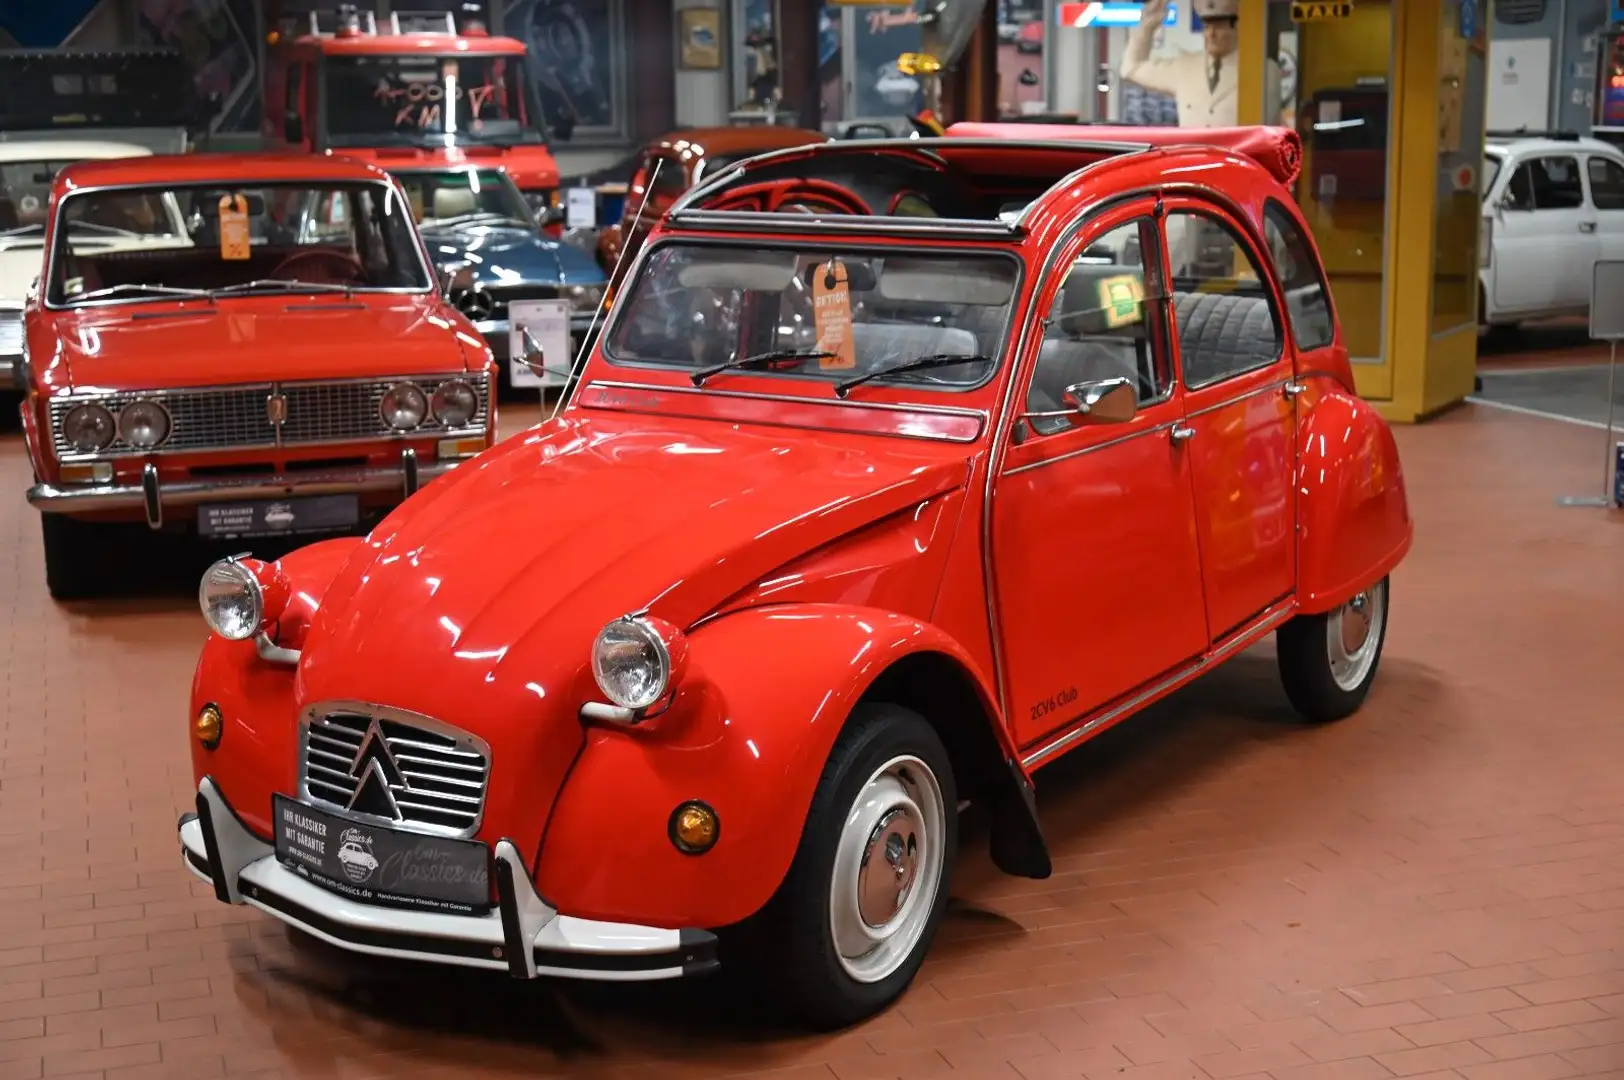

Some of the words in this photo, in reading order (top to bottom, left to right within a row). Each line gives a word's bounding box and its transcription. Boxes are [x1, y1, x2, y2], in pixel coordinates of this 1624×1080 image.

[1030, 696, 1056, 721] 2CV6
[1057, 687, 1078, 707] Club
[283, 808, 294, 825] IHR
[294, 812, 328, 837] KLASSIKER
[285, 826, 296, 842] MIT
[297, 831, 326, 855] GARANTIE
[311, 872, 373, 898] www.om-classics.de
